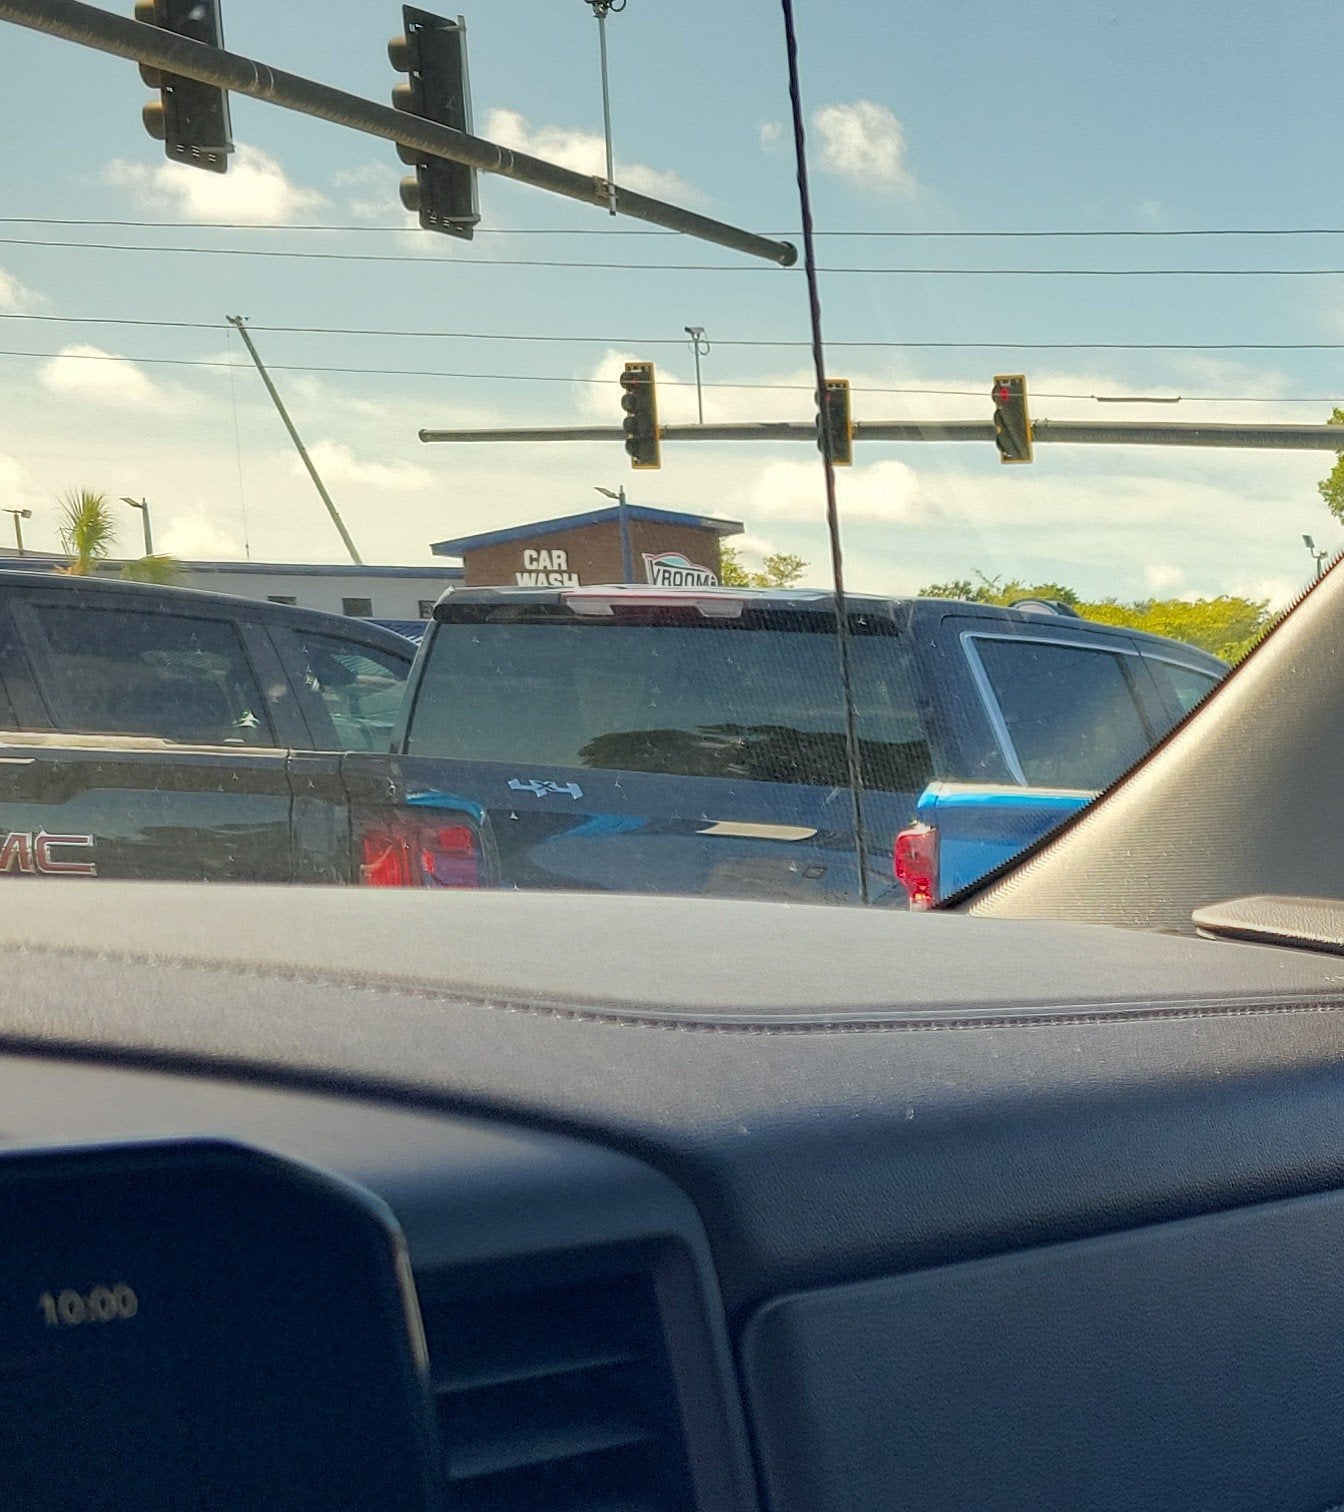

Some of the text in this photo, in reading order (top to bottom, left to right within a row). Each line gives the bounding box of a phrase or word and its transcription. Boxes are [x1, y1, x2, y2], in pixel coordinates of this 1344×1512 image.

[523, 549, 568, 571] CAR
[515, 572, 580, 587] WASH
[38, 1282, 139, 1327] 10:00
